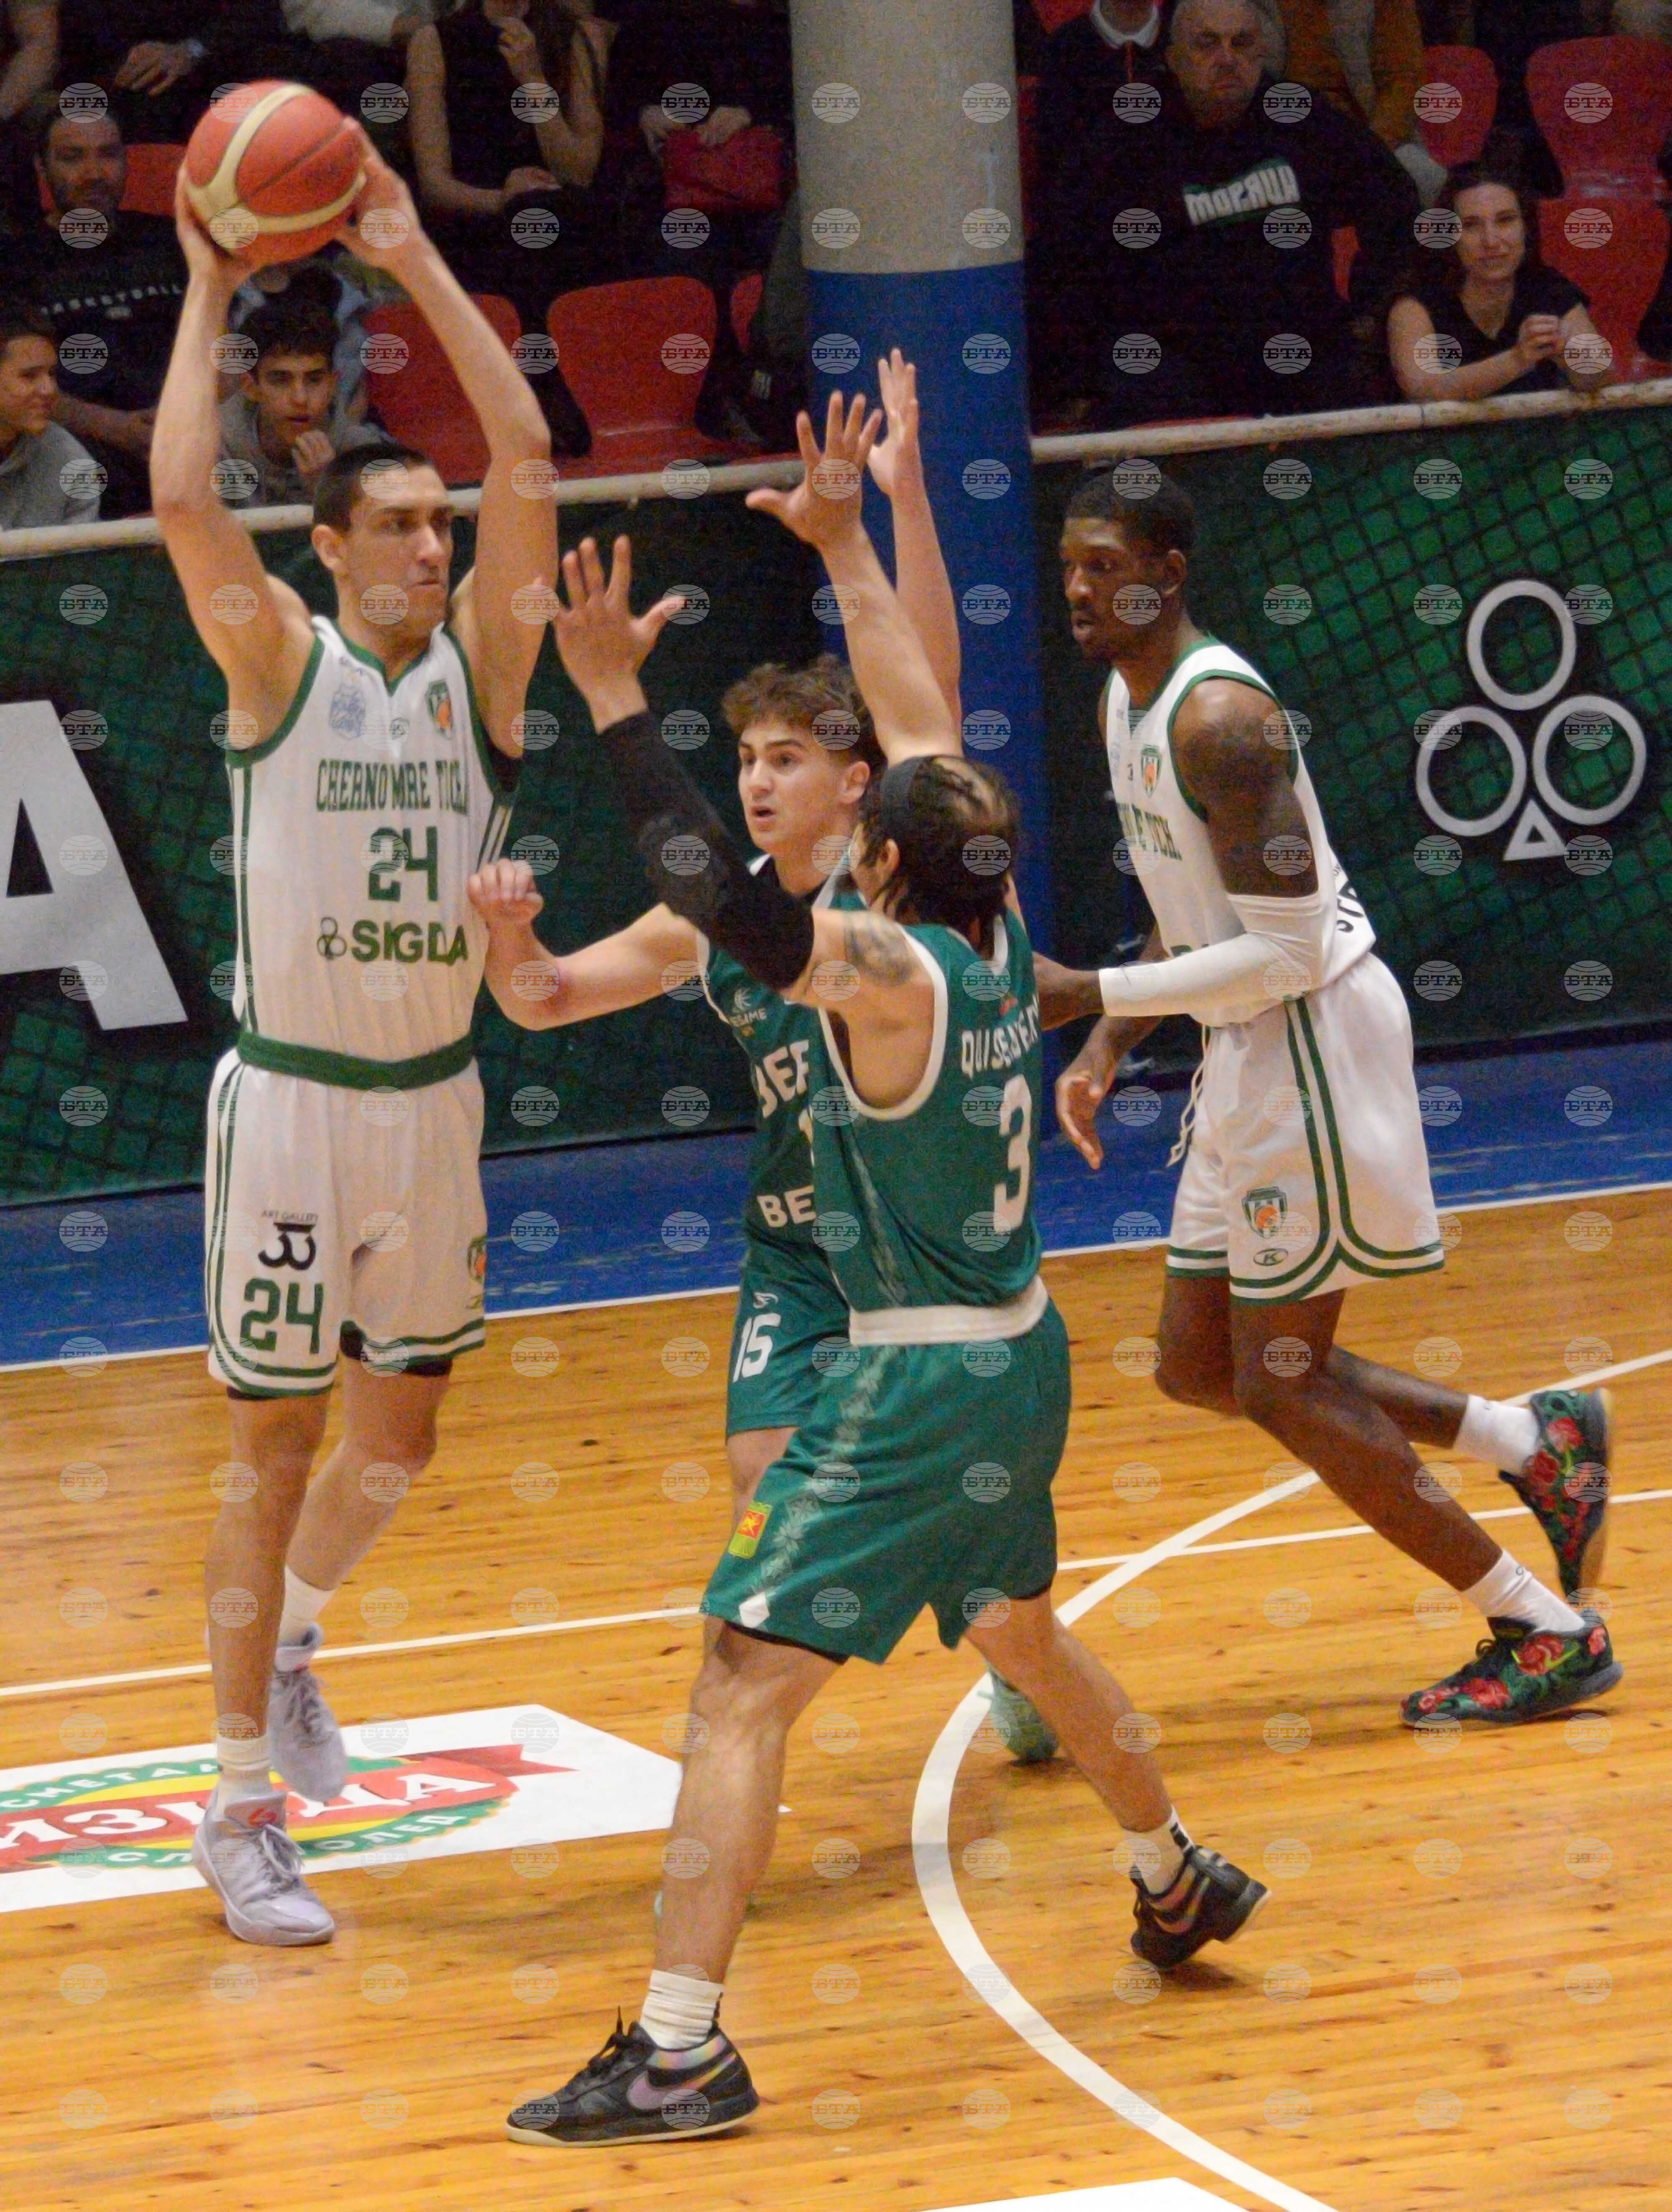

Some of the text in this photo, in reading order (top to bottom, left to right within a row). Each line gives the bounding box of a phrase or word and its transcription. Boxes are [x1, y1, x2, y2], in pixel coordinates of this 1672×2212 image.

[368, 825, 438, 902] 24
[993, 1074, 1032, 1233] 3
[240, 1278, 324, 1354] 24
[733, 1313, 781, 1383] 15
